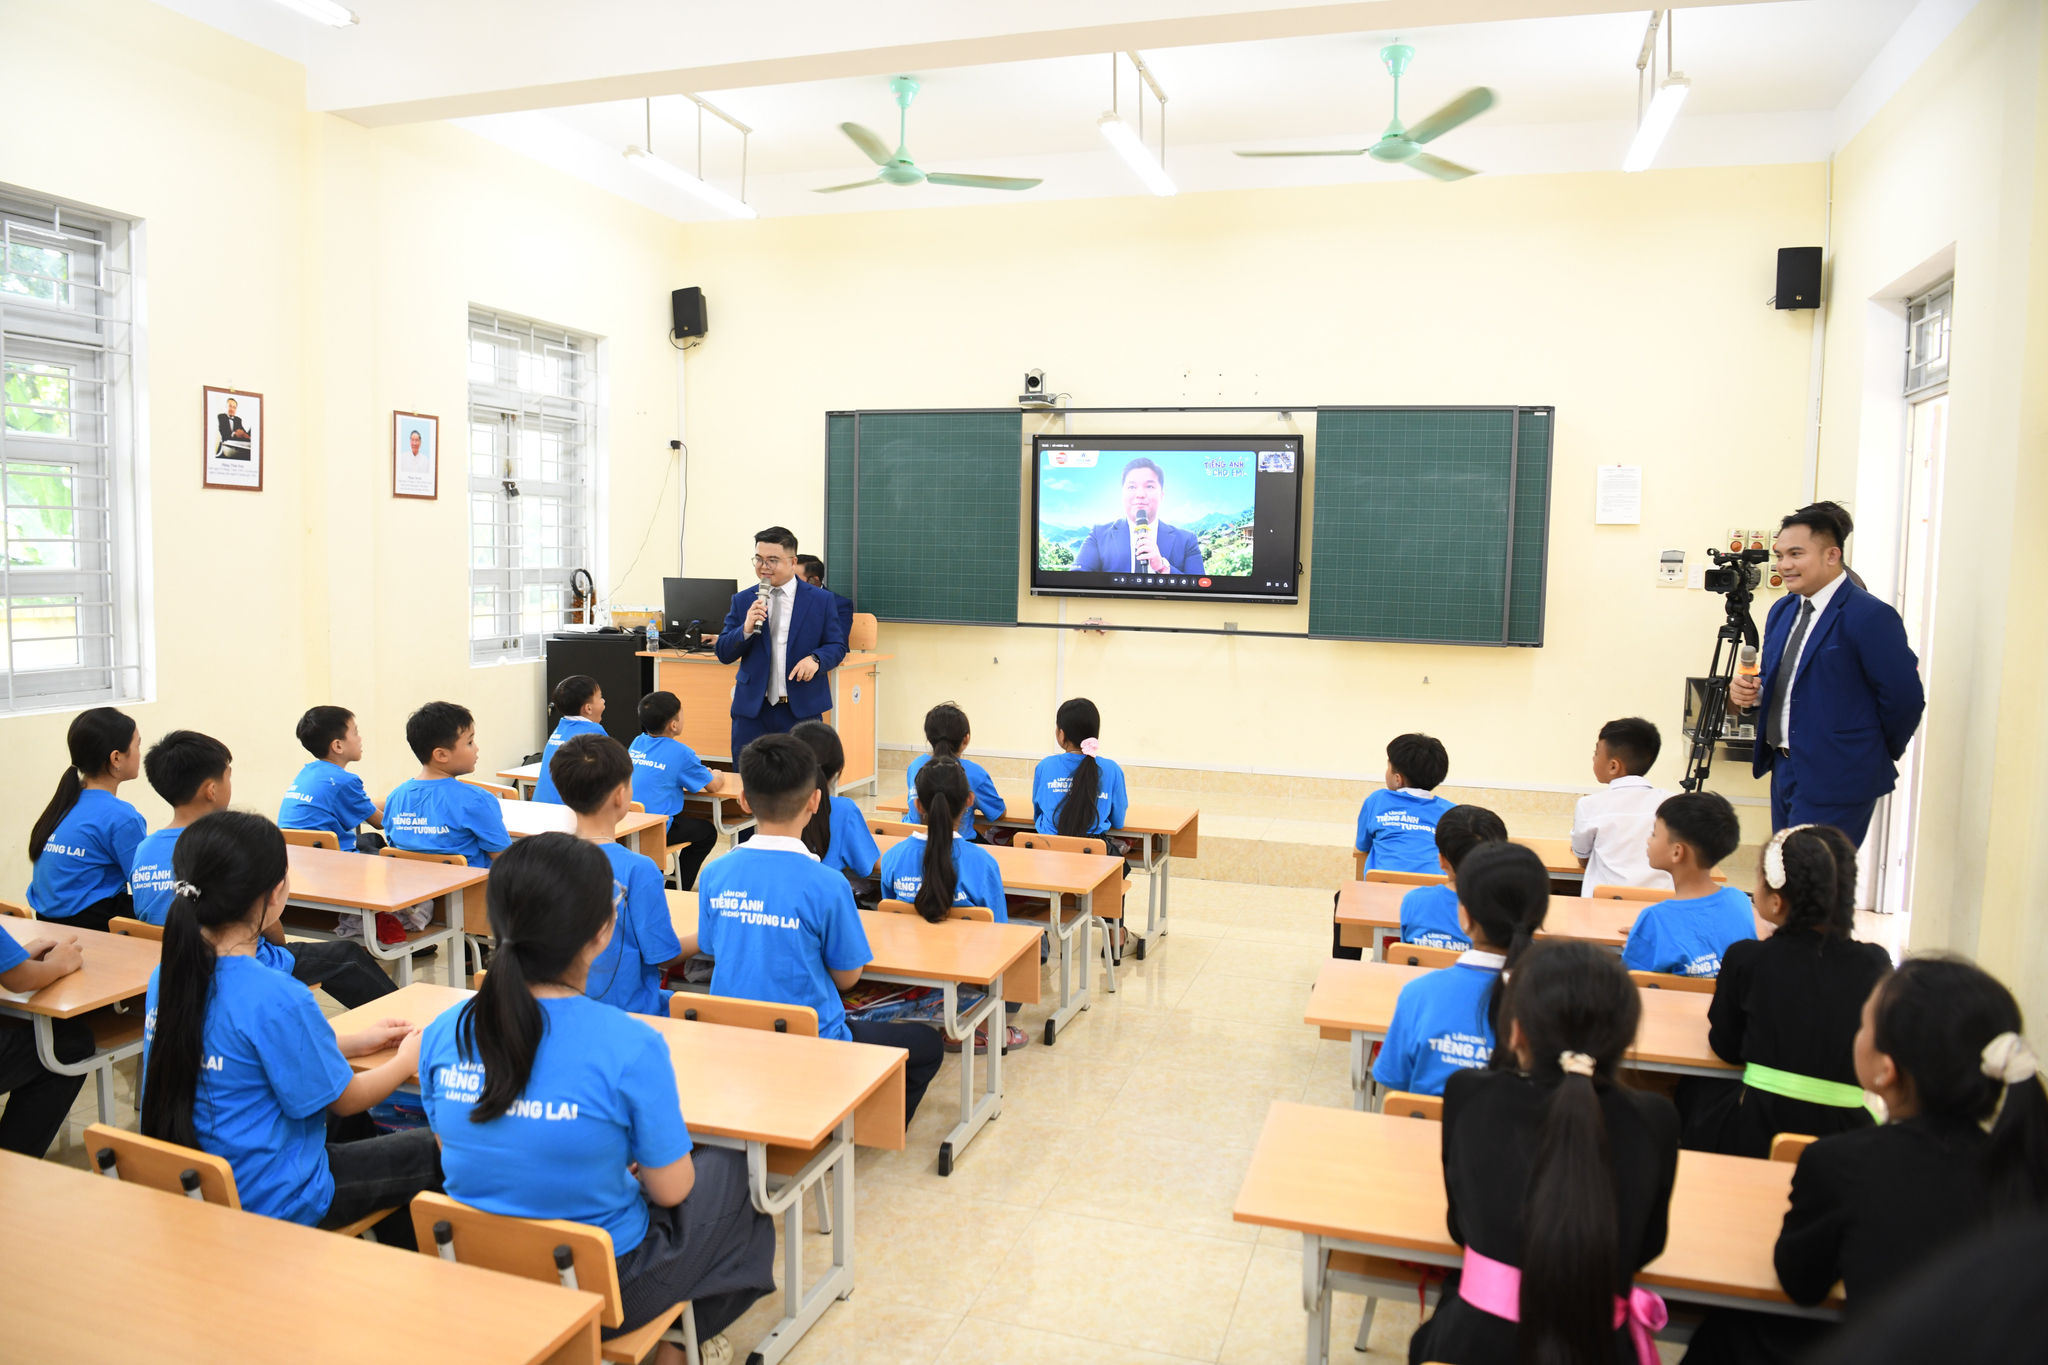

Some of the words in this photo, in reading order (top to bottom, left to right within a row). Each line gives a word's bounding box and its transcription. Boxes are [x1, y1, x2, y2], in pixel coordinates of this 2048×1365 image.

[411, 817, 428, 825] ANH
[66, 845, 86, 857] LAI
[152, 870, 172, 881] ANH
[709, 893, 739, 910] TIẾNG
[739, 899, 764, 912] ANH
[740, 911, 780, 927] TƯƠNG
[780, 916, 800, 930] LAI
[1445, 940, 1470, 952] ANH
[1428, 1034, 1475, 1058] TIẾNG
[440, 1063, 480, 1092] TIẾNG
[445, 1089, 461, 1102] LÀM
[545, 1101, 579, 1120] LAI
